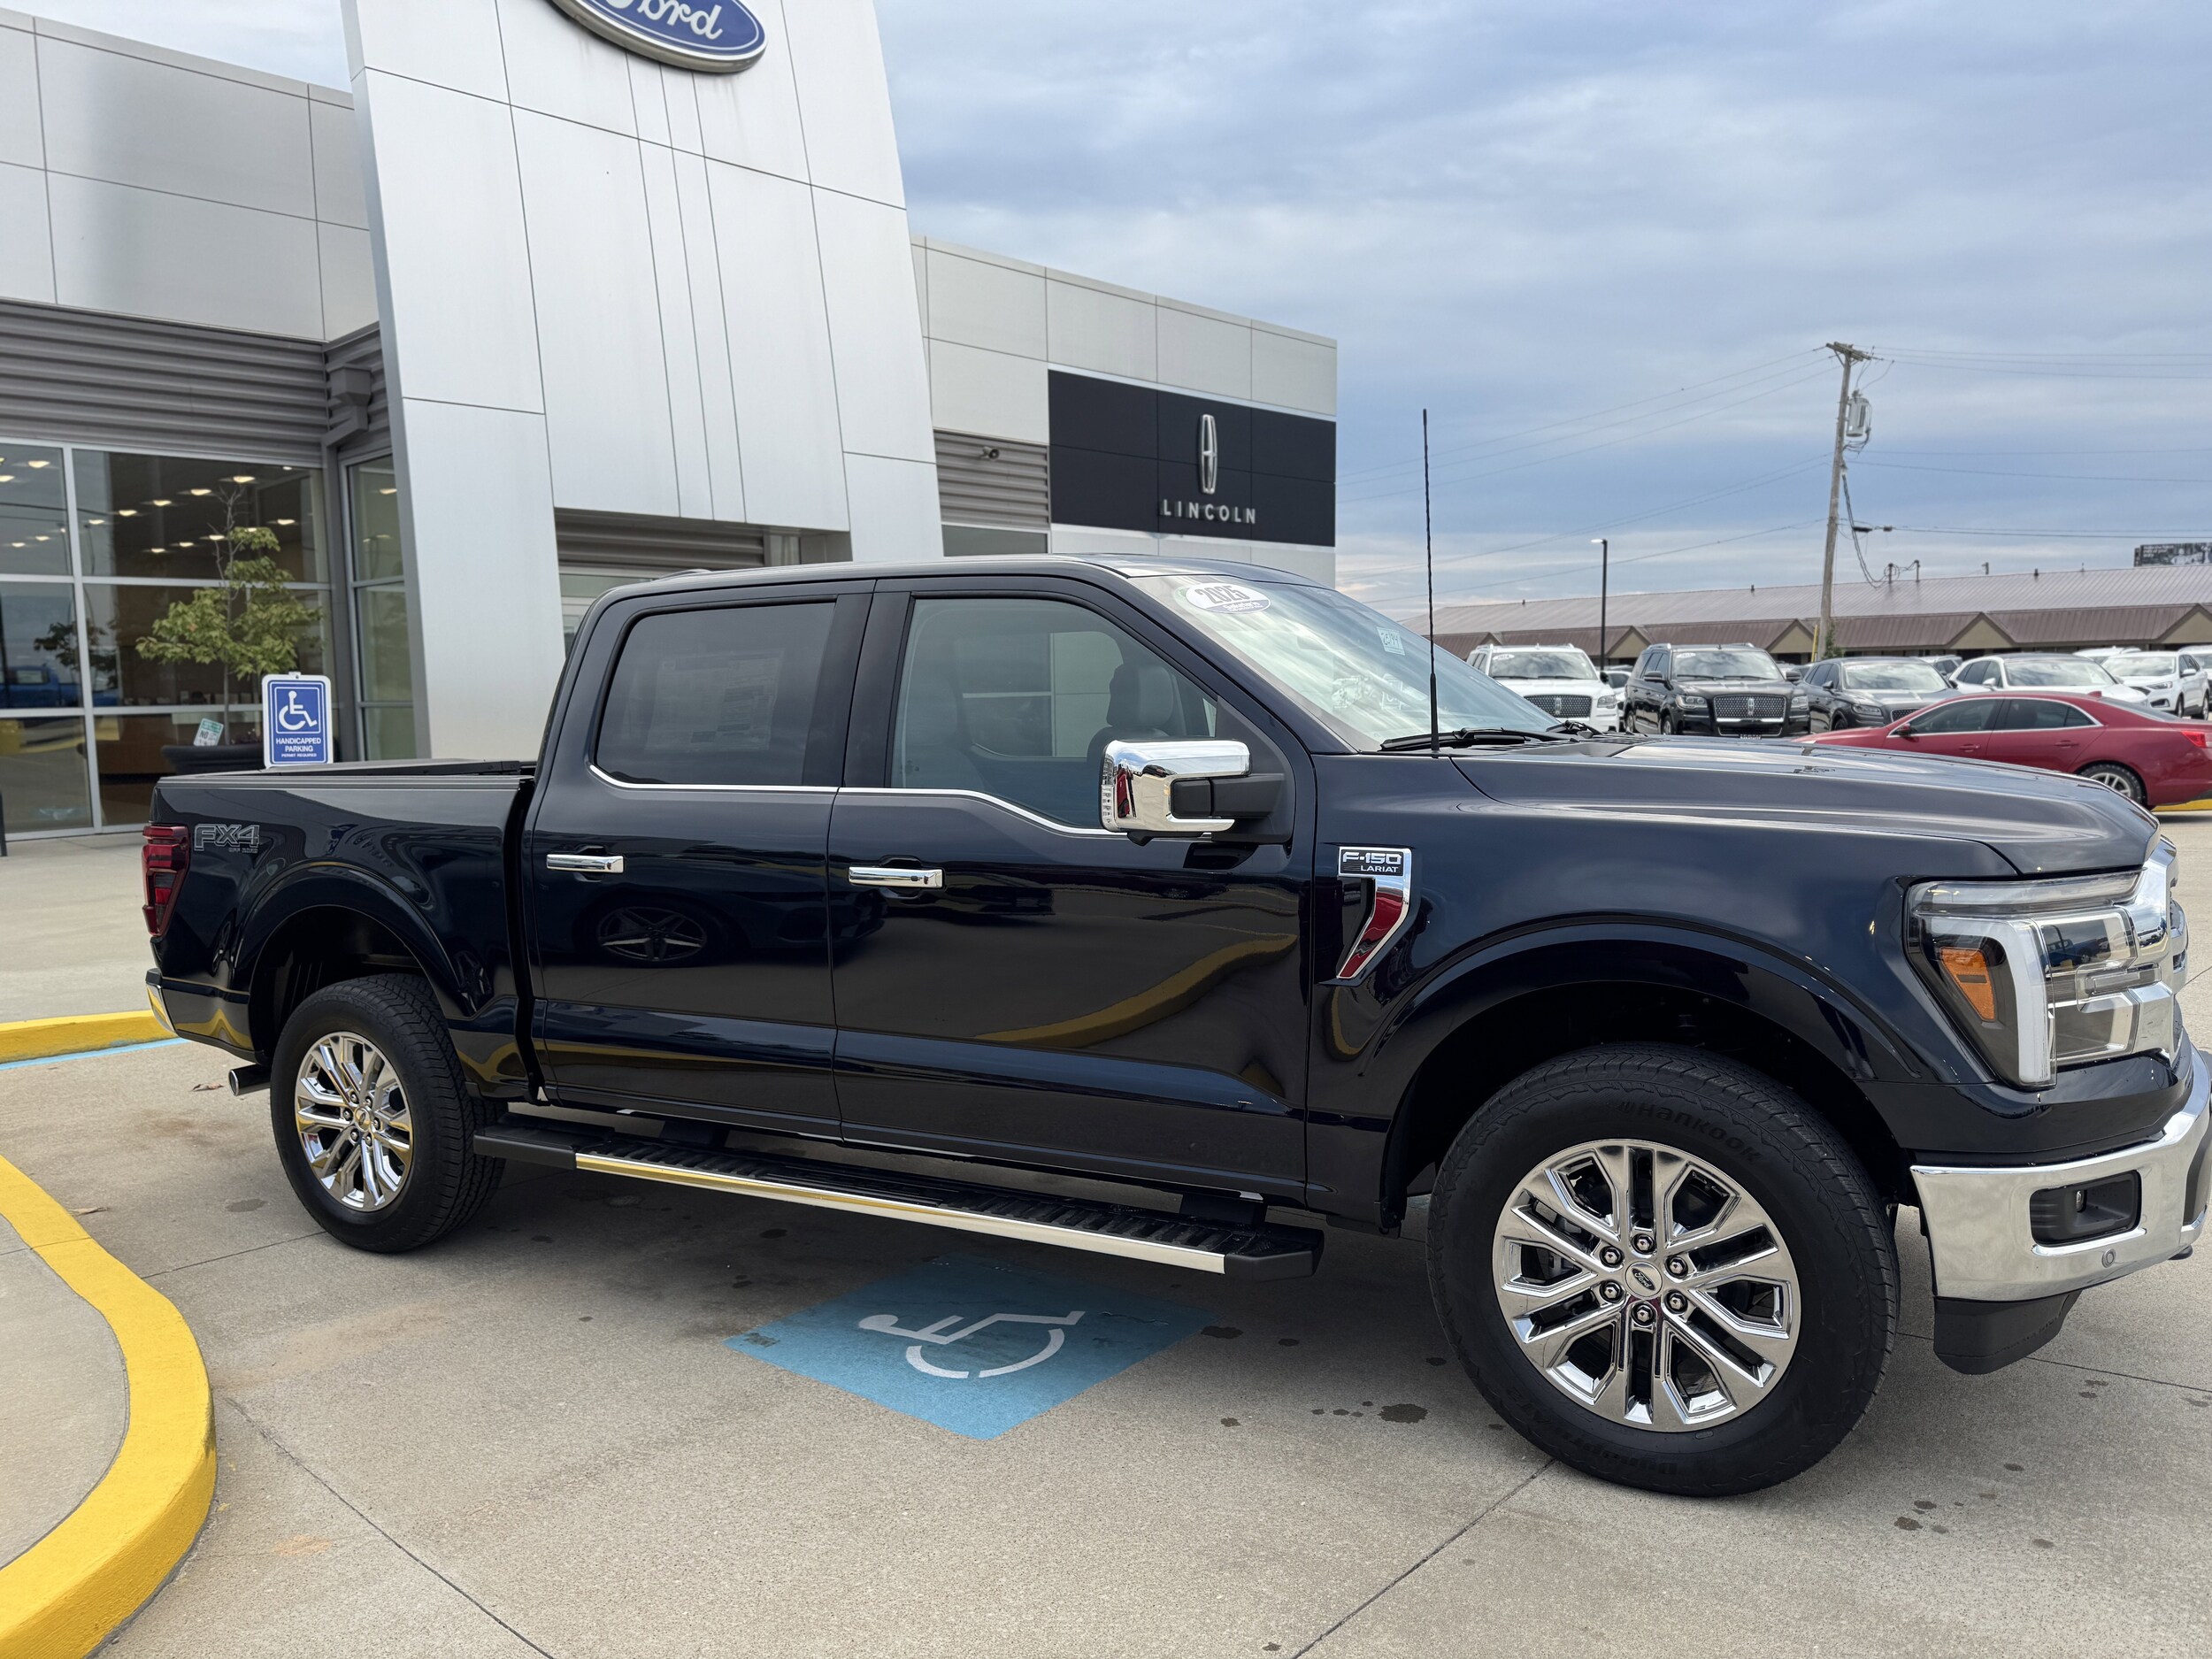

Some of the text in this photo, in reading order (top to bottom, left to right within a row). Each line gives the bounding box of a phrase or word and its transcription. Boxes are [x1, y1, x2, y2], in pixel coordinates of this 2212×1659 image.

[604, 0, 723, 40] ord
[1163, 499, 1256, 524] LINCOLN
[1194, 585, 1250, 604] 2025
[194, 824, 260, 851] FX4
[1342, 851, 1402, 865] F-150
[1634, 1271, 1652, 1288] Ford
